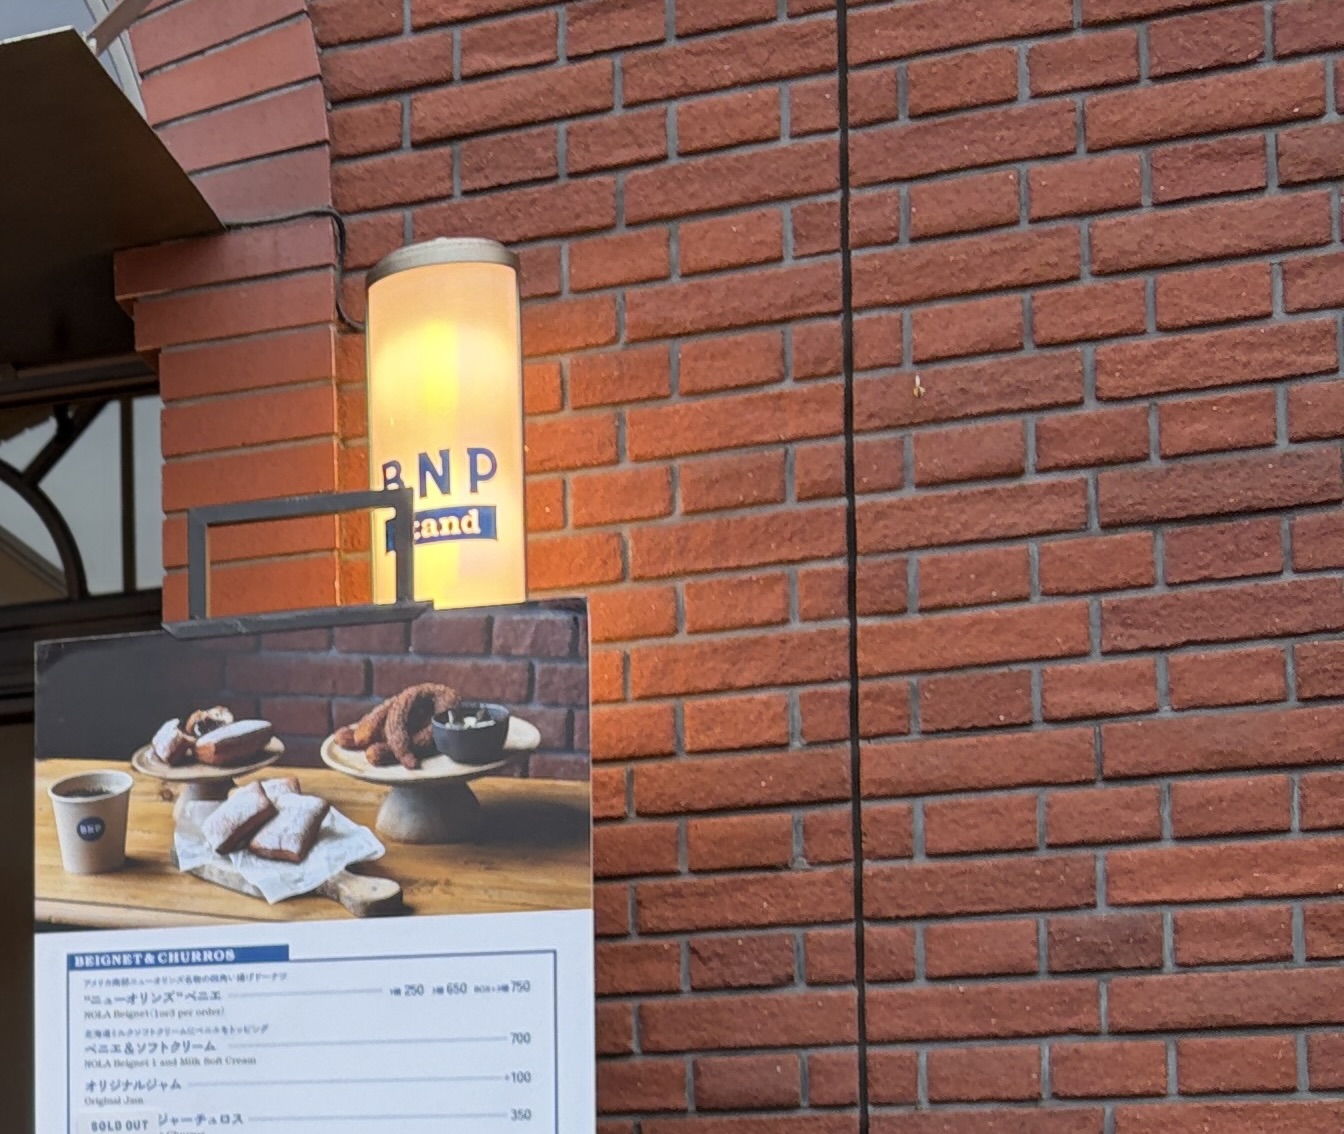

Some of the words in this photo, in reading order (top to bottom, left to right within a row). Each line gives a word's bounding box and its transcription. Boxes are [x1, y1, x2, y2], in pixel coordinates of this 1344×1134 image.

[382, 447, 497, 497] BNP
[413, 508, 482, 540] and
[404, 983, 424, 996] 250
[447, 982, 467, 995] 650
[510, 979, 531, 993] 750
[510, 1031, 531, 1045] 700
[160, 1057, 177, 1067] and
[225, 1055, 257, 1066] Cream
[85, 1078, 182, 1091] オリジナルジャム
[84, 1095, 121, 1106] Original
[123, 1095, 144, 1106] Jam
[510, 1108, 532, 1121] 350
[90, 1120, 123, 1132] SOLD
[125, 1119, 149, 1132] OUT
